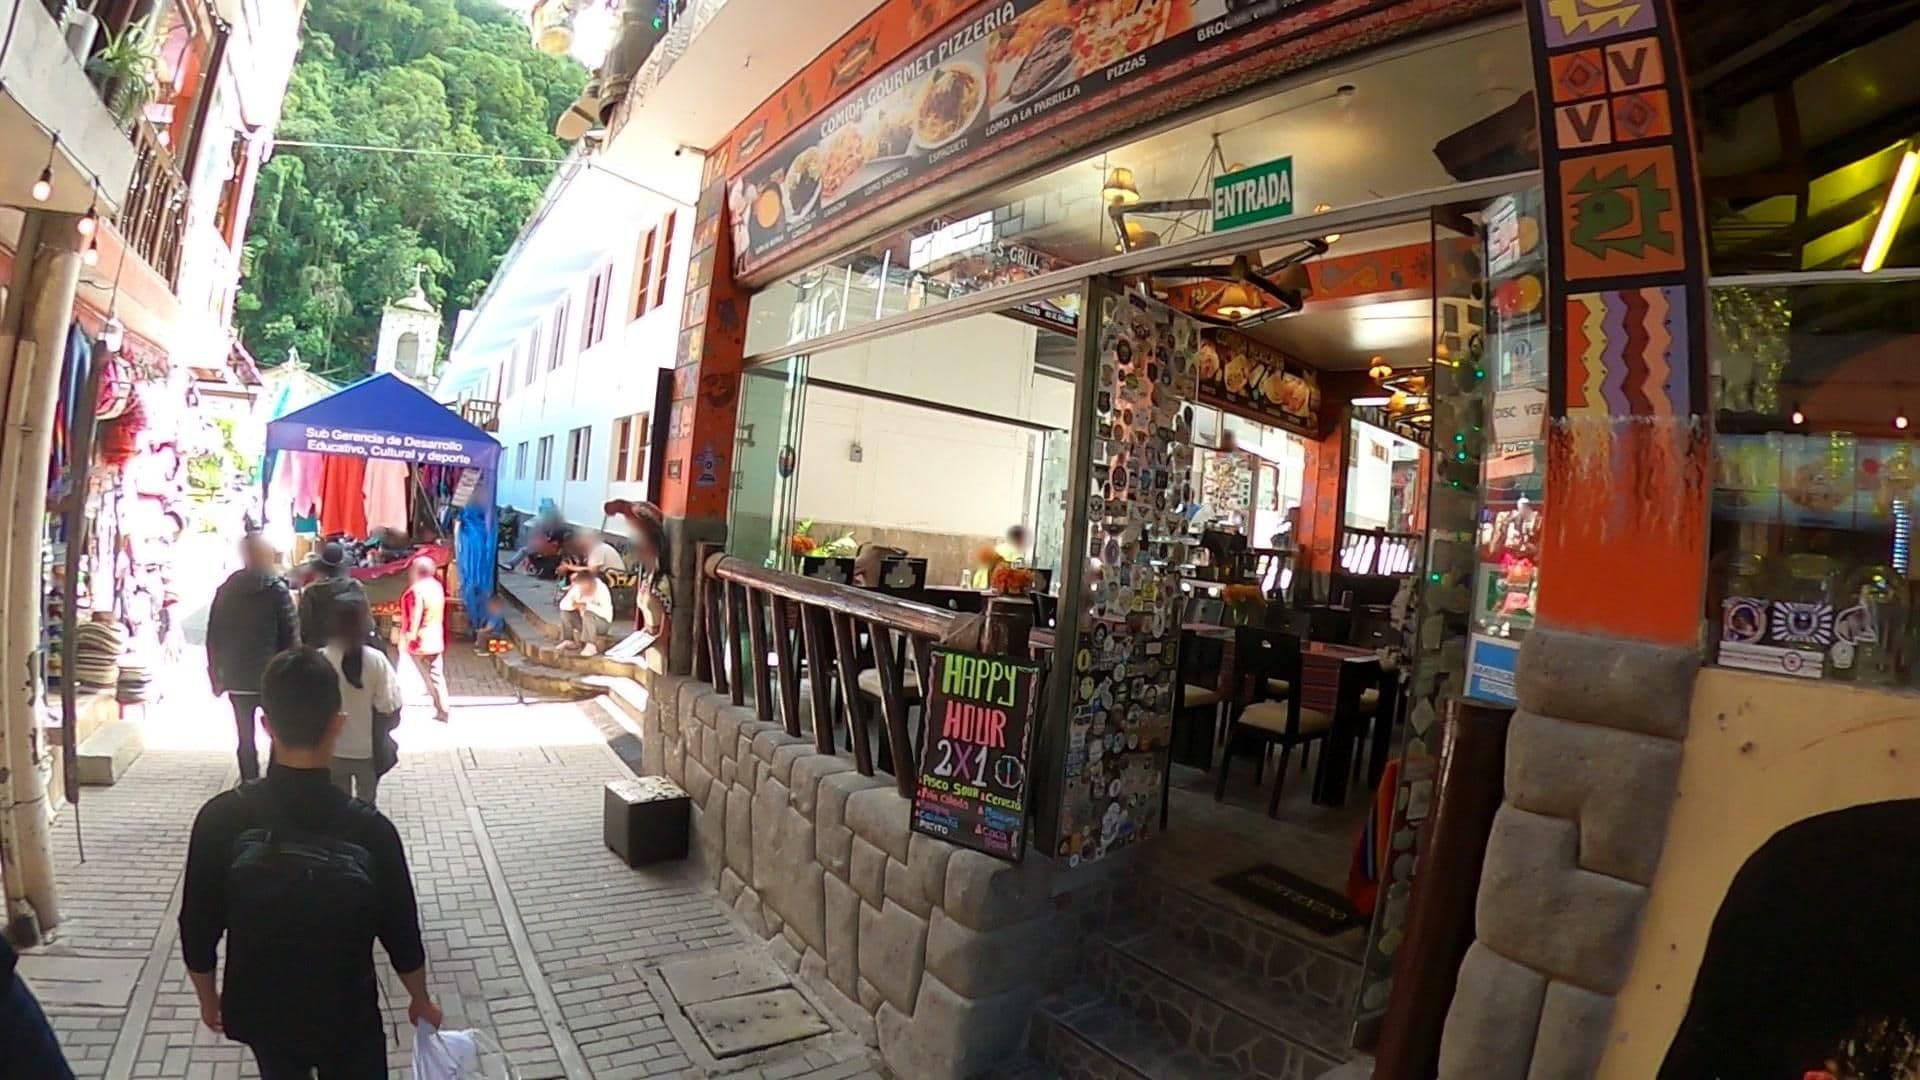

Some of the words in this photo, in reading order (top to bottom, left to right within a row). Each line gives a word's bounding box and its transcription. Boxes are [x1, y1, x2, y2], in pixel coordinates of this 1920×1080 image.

[820, 98, 865, 138] COMIDA
[867, 48, 937, 106] GOURMET
[938, 2, 1015, 61] PIZZERIA
[1106, 54, 1147, 81] PIZZAS
[985, 117, 1010, 137] LOMO
[1011, 112, 1019, 125] A
[1020, 106, 1033, 121] LA
[1034, 84, 1081, 113] PARRILLA
[1215, 170, 1290, 219] ENTRADA
[1009, 245, 1039, 270] GRILL
[305, 428, 330, 439] Sub
[331, 429, 385, 444] Gerencia
[386, 435, 402, 446] de
[404, 437, 463, 452] Desarrollo
[307, 439, 368, 455] Educativo,
[370, 445, 416, 460] Cultural
[417, 450, 427, 462] y
[427, 451, 471, 465] deporte
[941, 652, 1018, 708] HAPPY
[942, 699, 1008, 749] HOUR
[933, 738, 989, 788] 2X1
